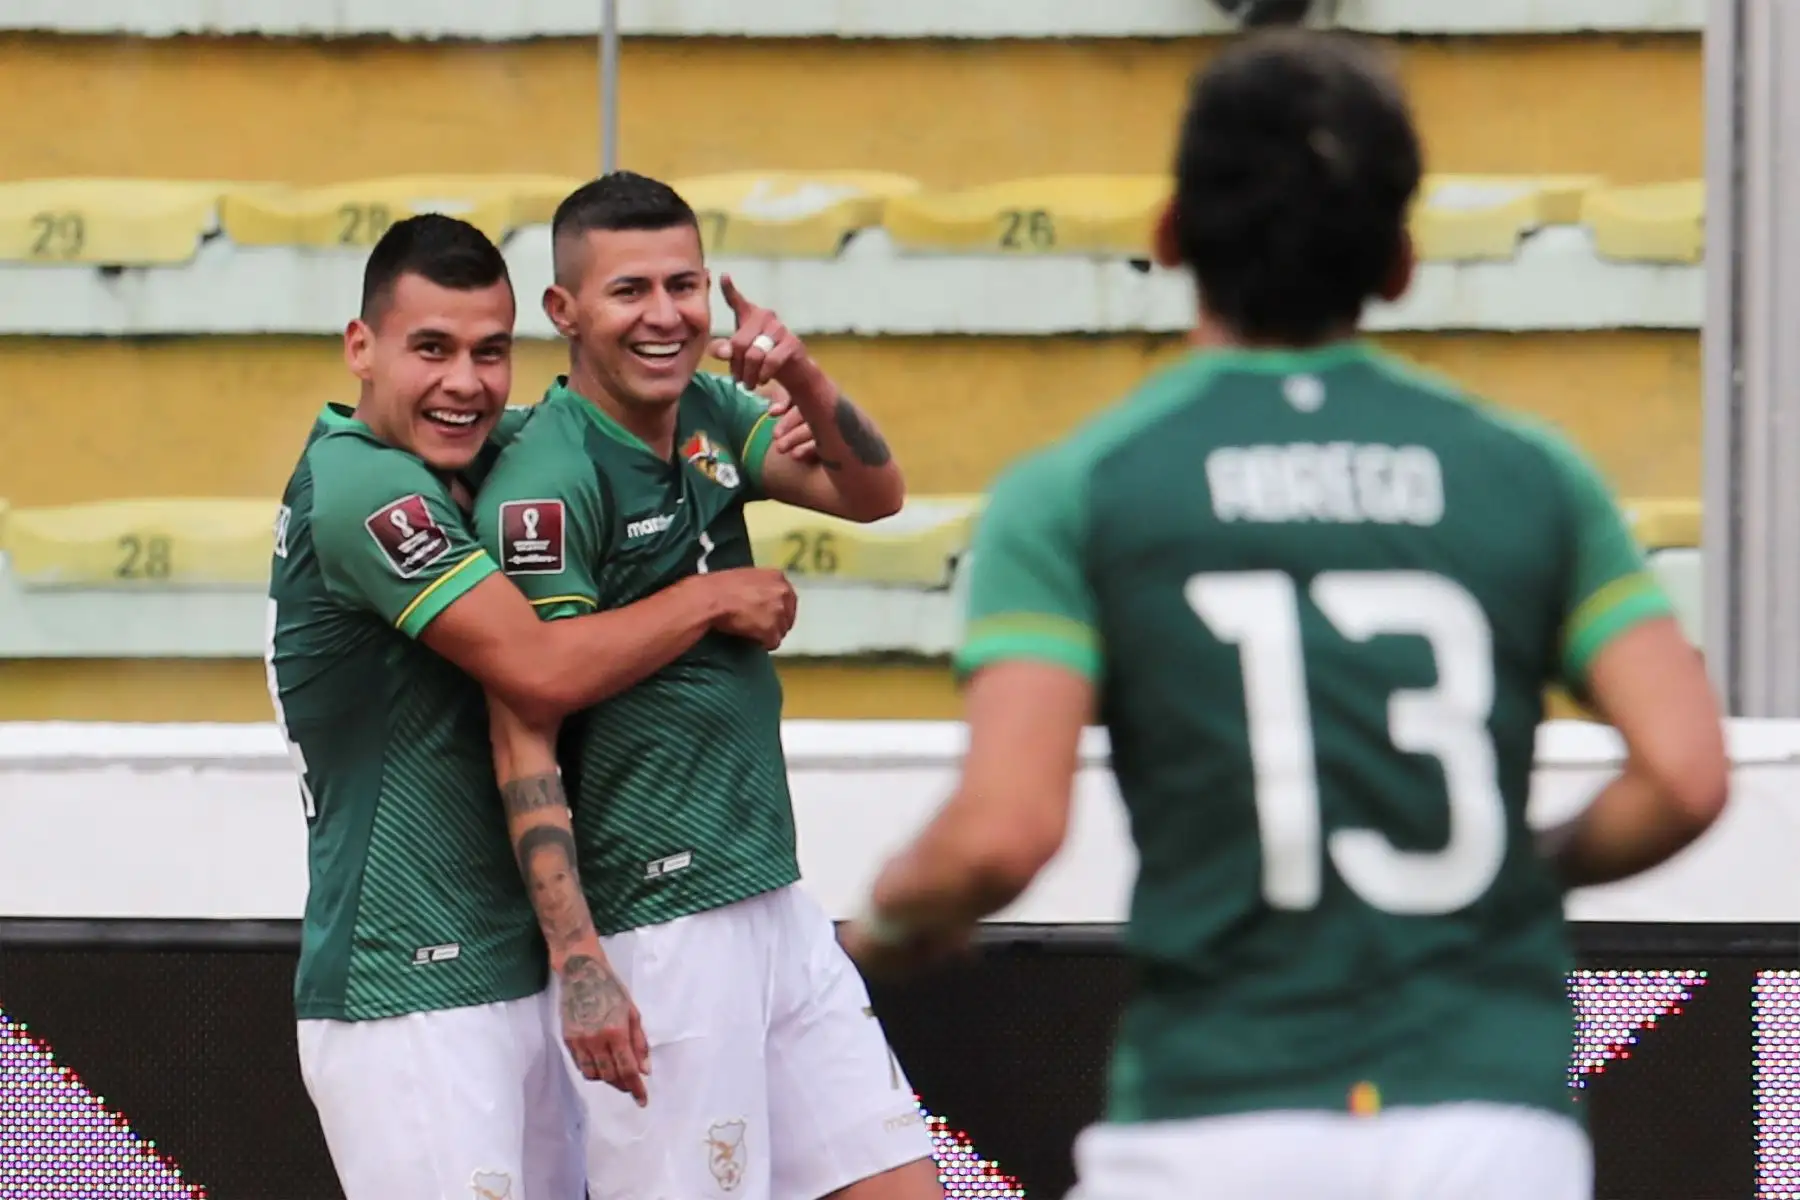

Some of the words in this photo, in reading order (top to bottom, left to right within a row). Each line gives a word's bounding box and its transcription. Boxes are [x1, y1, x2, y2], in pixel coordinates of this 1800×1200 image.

[30, 211, 86, 259] 29
[999, 209, 1055, 252] 26
[1205, 441, 1446, 526] ABREGO
[115, 534, 172, 578] 28
[784, 529, 838, 572] 26
[1184, 568, 1506, 916] 13
